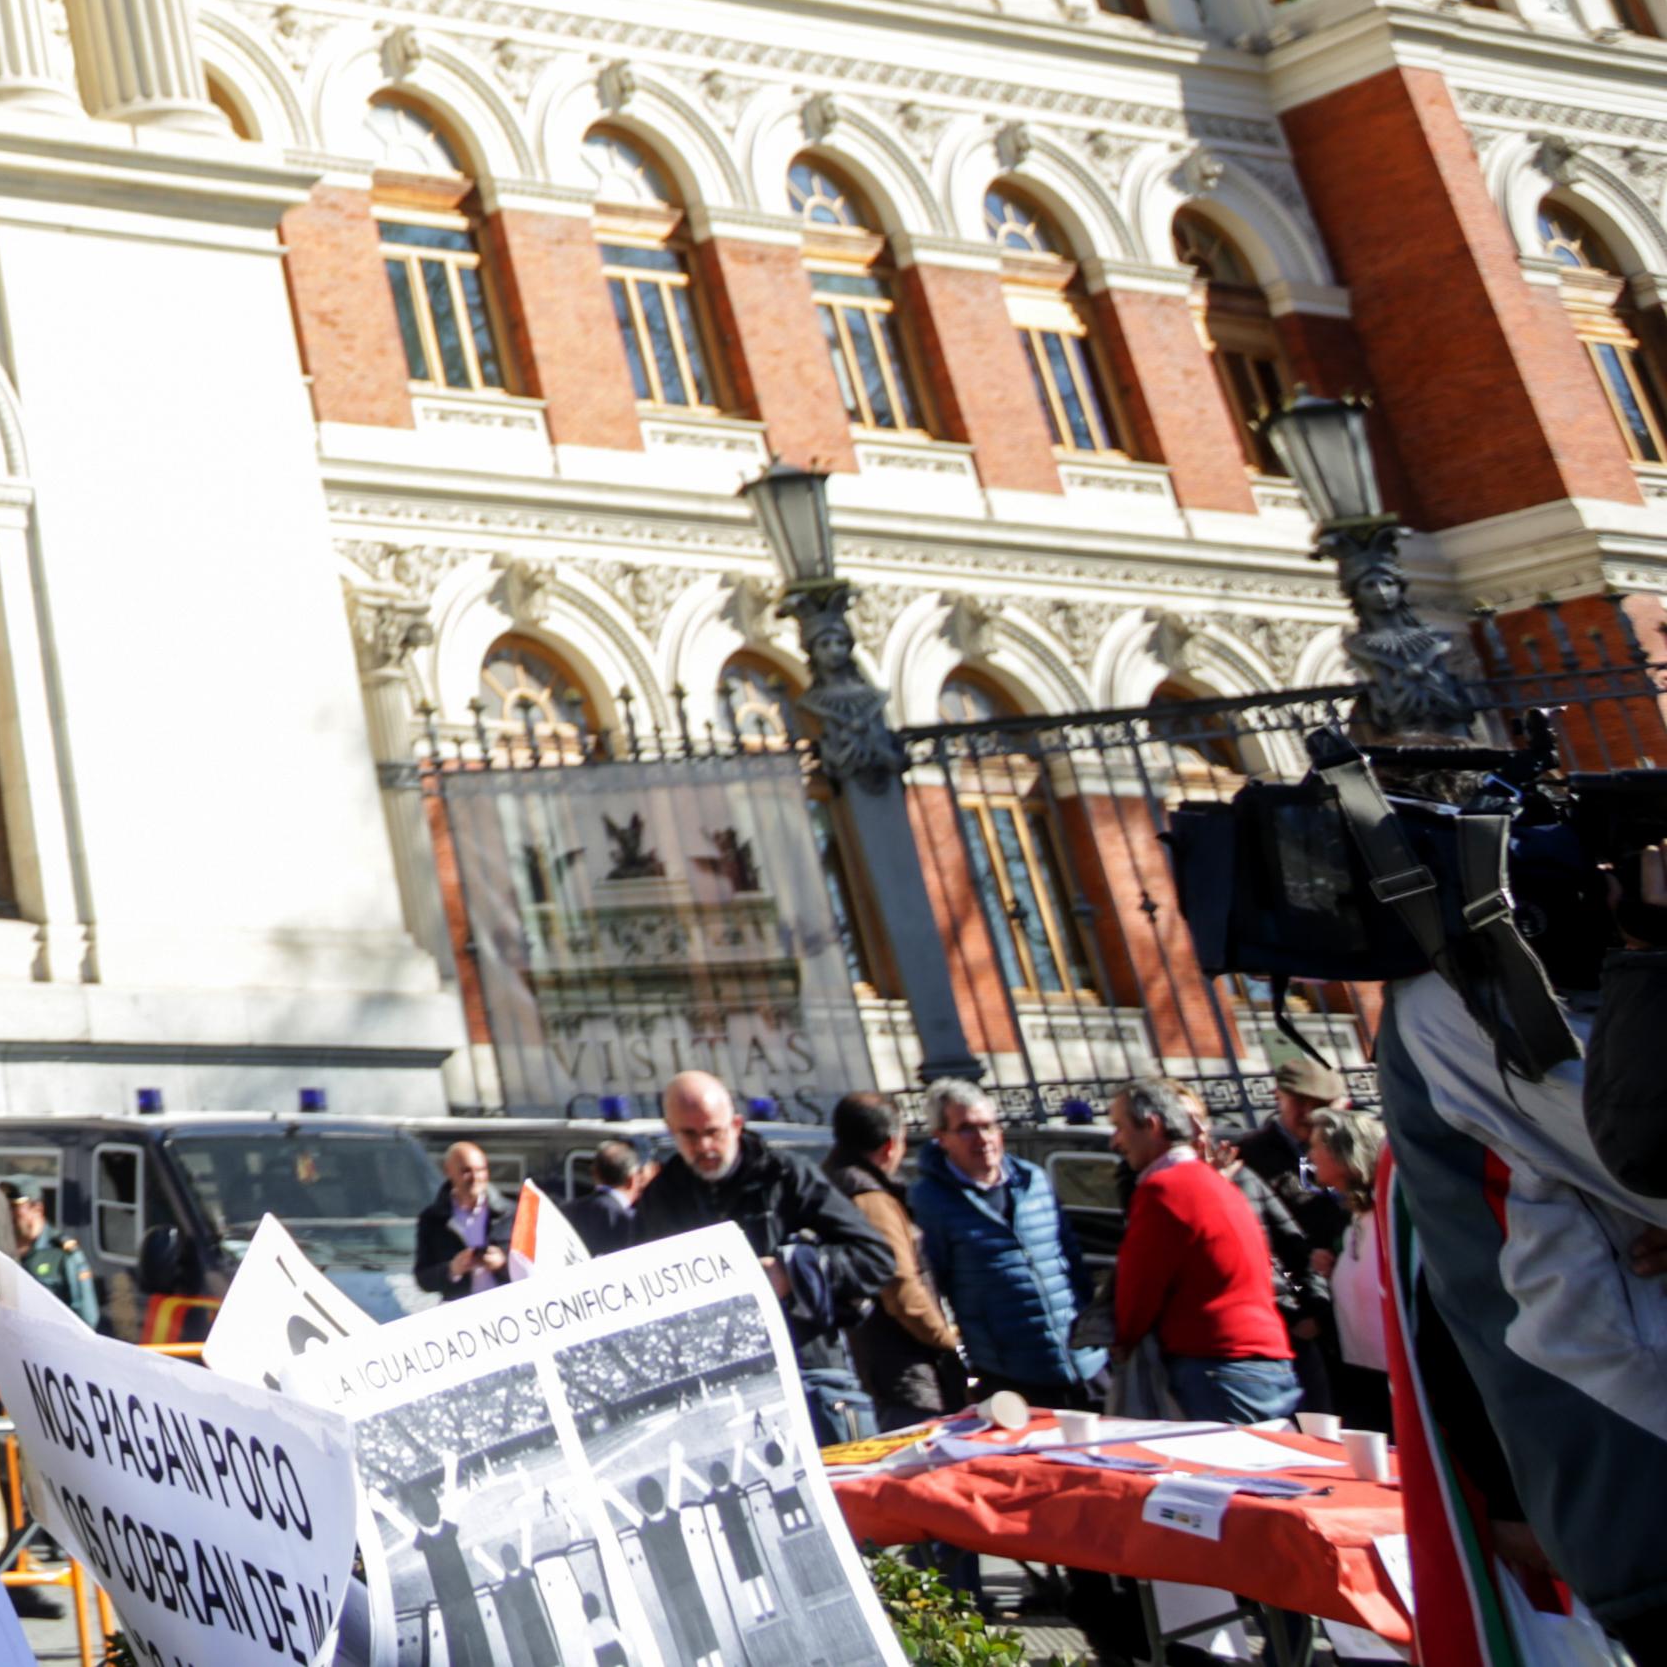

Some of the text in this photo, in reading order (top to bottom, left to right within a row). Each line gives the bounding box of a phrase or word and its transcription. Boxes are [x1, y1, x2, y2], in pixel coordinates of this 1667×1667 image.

[550, 1031, 815, 1082] VISITAS
[323, 1253, 736, 1405] LA IGUALDAD NO SIGNIFICA JUSTICIA
[21, 1359, 312, 1542] NOS PAGAN POCO
[60, 1486, 112, 1579] OS
[102, 1506, 258, 1642] COBRAN
[241, 1559, 310, 1667] DE
